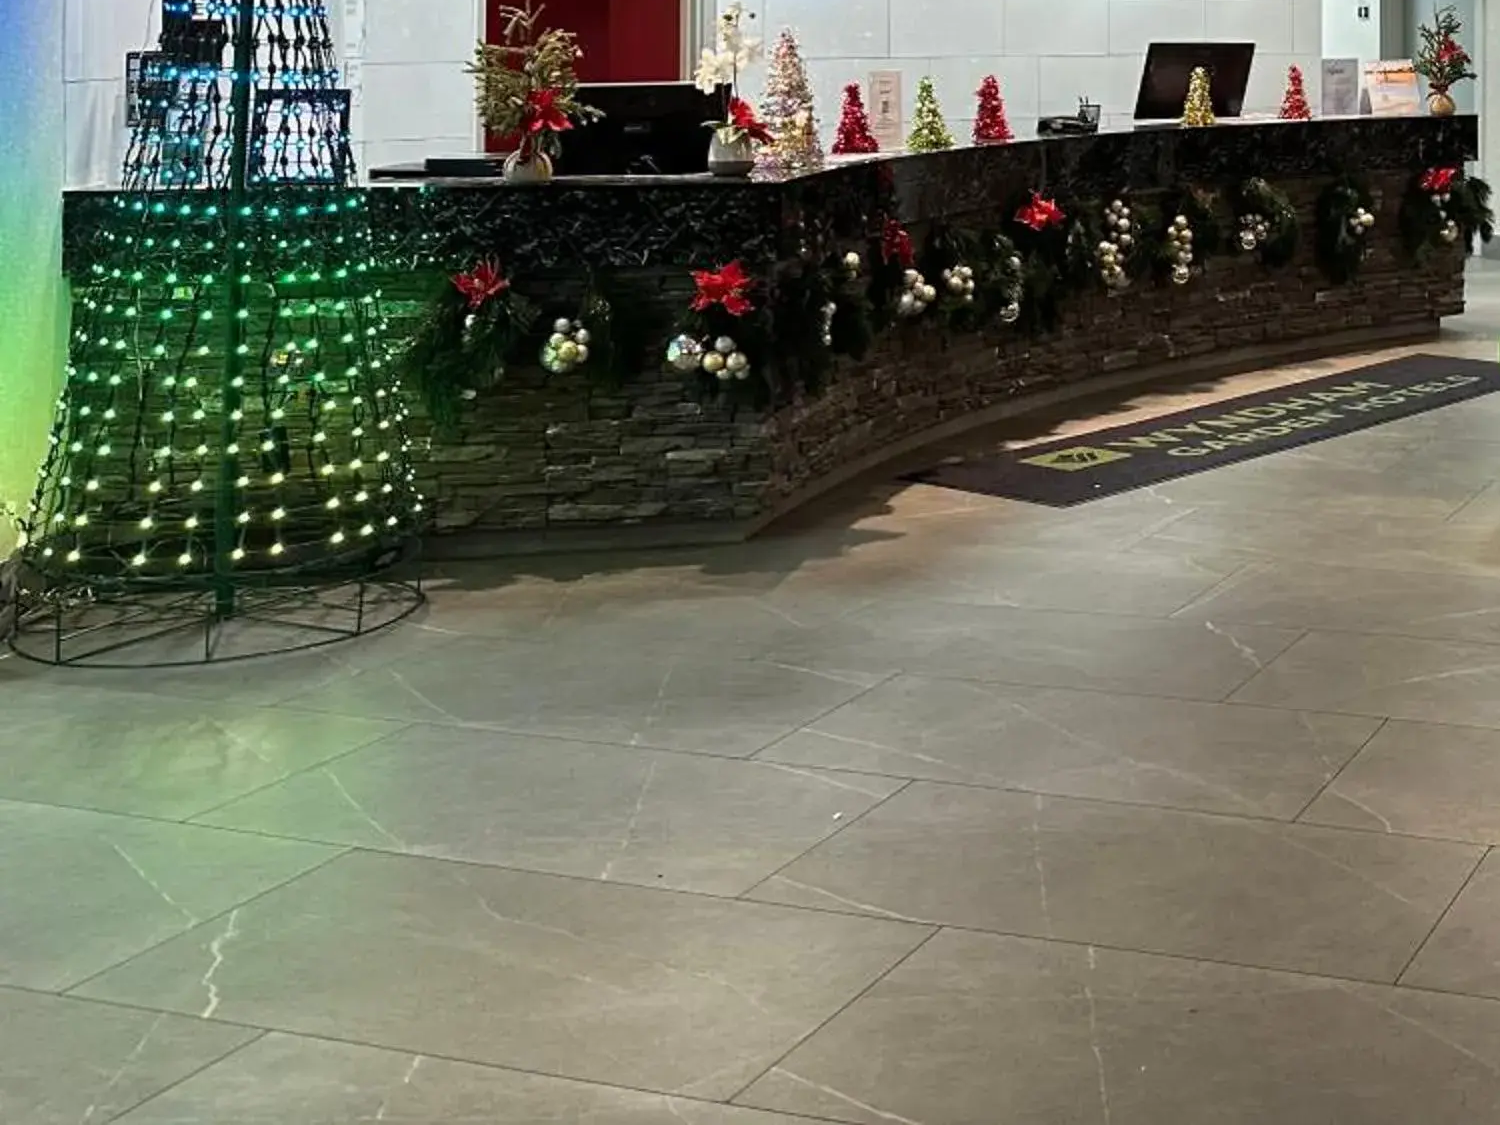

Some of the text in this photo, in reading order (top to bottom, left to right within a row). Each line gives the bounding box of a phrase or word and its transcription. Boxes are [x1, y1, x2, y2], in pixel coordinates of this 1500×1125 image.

[1108, 381, 1391, 449] WYNDHAM
[1167, 375, 1480, 455] GARDEN HOTELS
